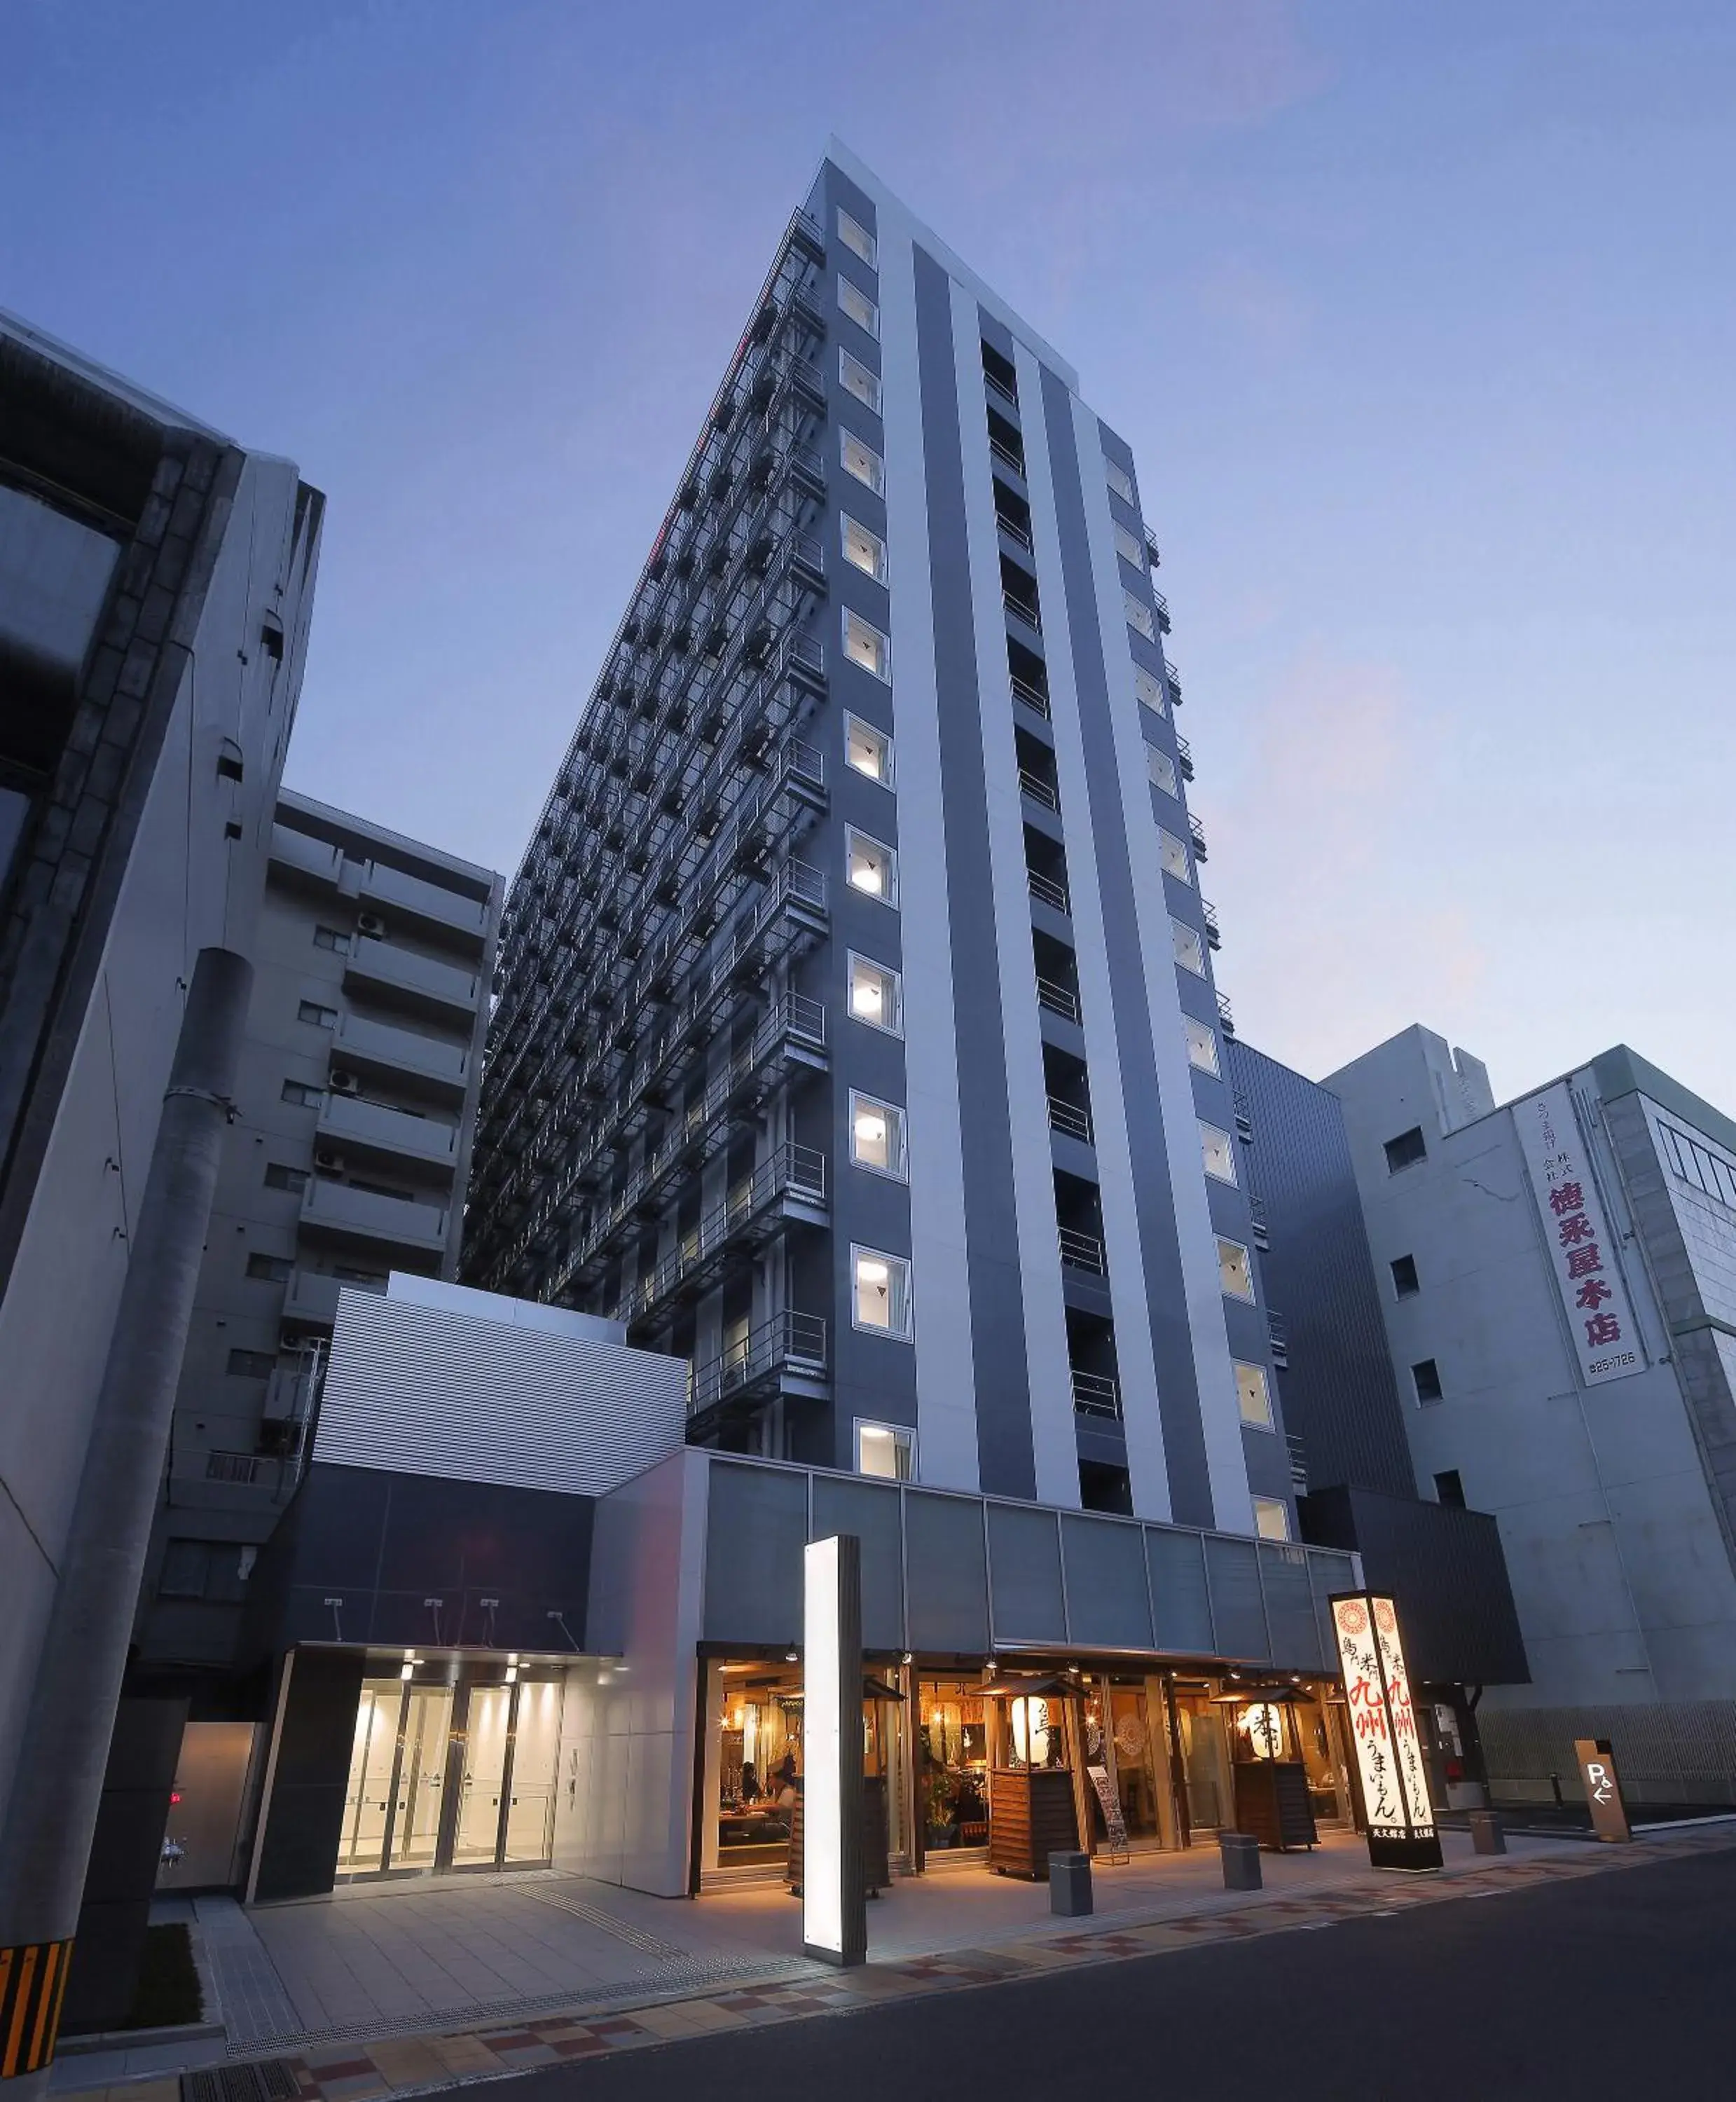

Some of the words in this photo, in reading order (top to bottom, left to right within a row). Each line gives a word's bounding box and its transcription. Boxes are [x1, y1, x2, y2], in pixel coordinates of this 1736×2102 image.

[1349, 1675, 1386, 1740] 九州
[1387, 1674, 1415, 1740] 九州
[1587, 1763, 1606, 1785] P
